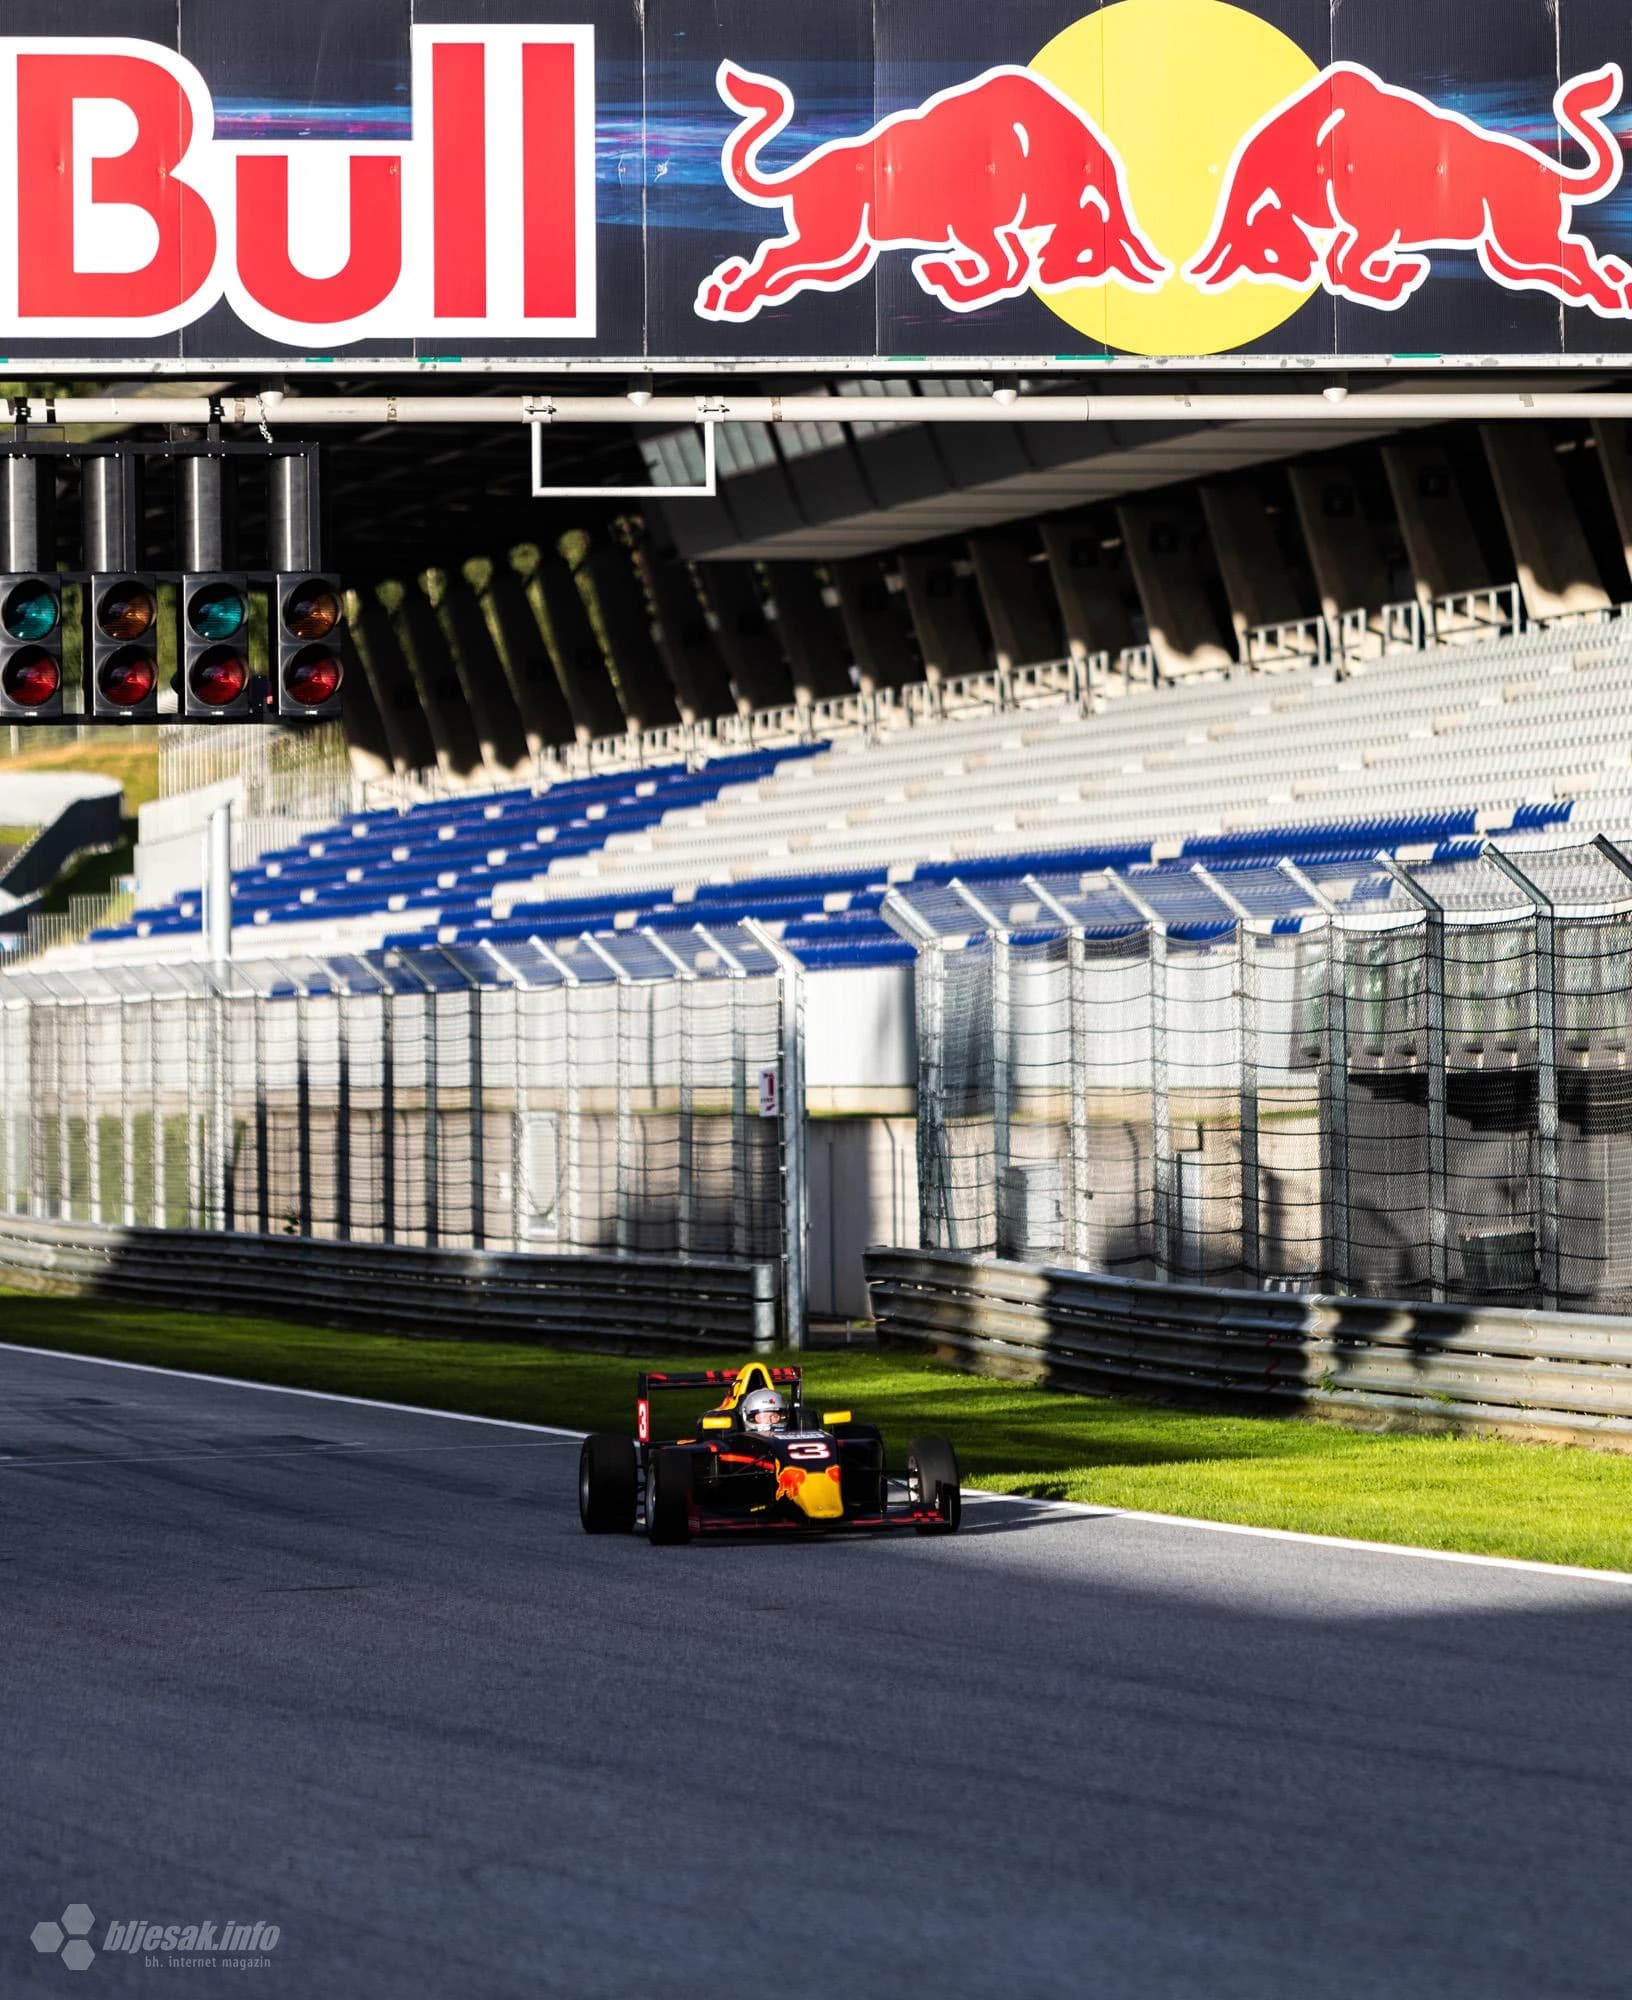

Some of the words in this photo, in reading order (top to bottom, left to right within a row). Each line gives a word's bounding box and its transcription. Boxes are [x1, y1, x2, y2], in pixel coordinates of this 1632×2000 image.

[10, 38, 582, 330] Bull
[639, 1403, 647, 1439] 3
[788, 1442, 831, 1460] 3
